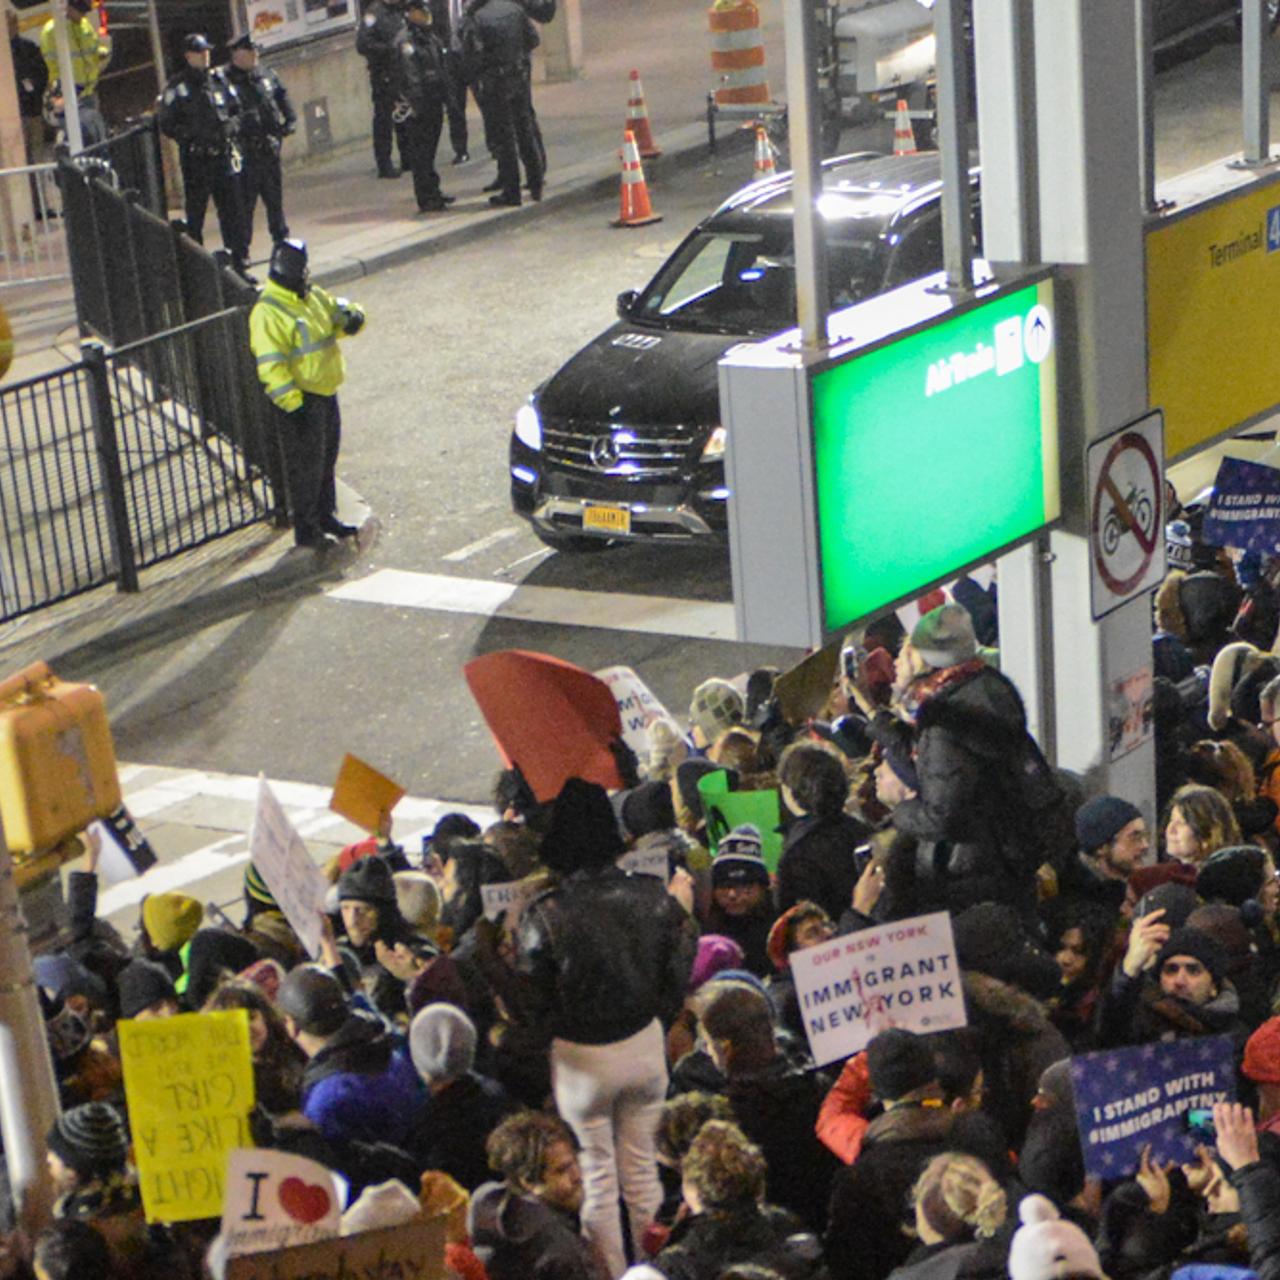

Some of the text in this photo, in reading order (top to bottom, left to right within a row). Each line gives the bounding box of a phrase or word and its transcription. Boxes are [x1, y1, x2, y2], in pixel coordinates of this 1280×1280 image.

[1209, 222, 1263, 267] Terminal
[1224, 493, 1263, 507] STAND
[812, 925, 928, 966] OUR NEW YORK
[804, 953, 951, 1010] IMMIGRANT
[810, 980, 956, 1036] NEW YORK
[164, 1071, 237, 1113] GIRL
[1092, 1070, 1216, 1124] I STAND WITH
[137, 1111, 247, 1159] LIKE A
[151, 1164, 225, 1205] IGHT
[241, 1171, 270, 1221] I
